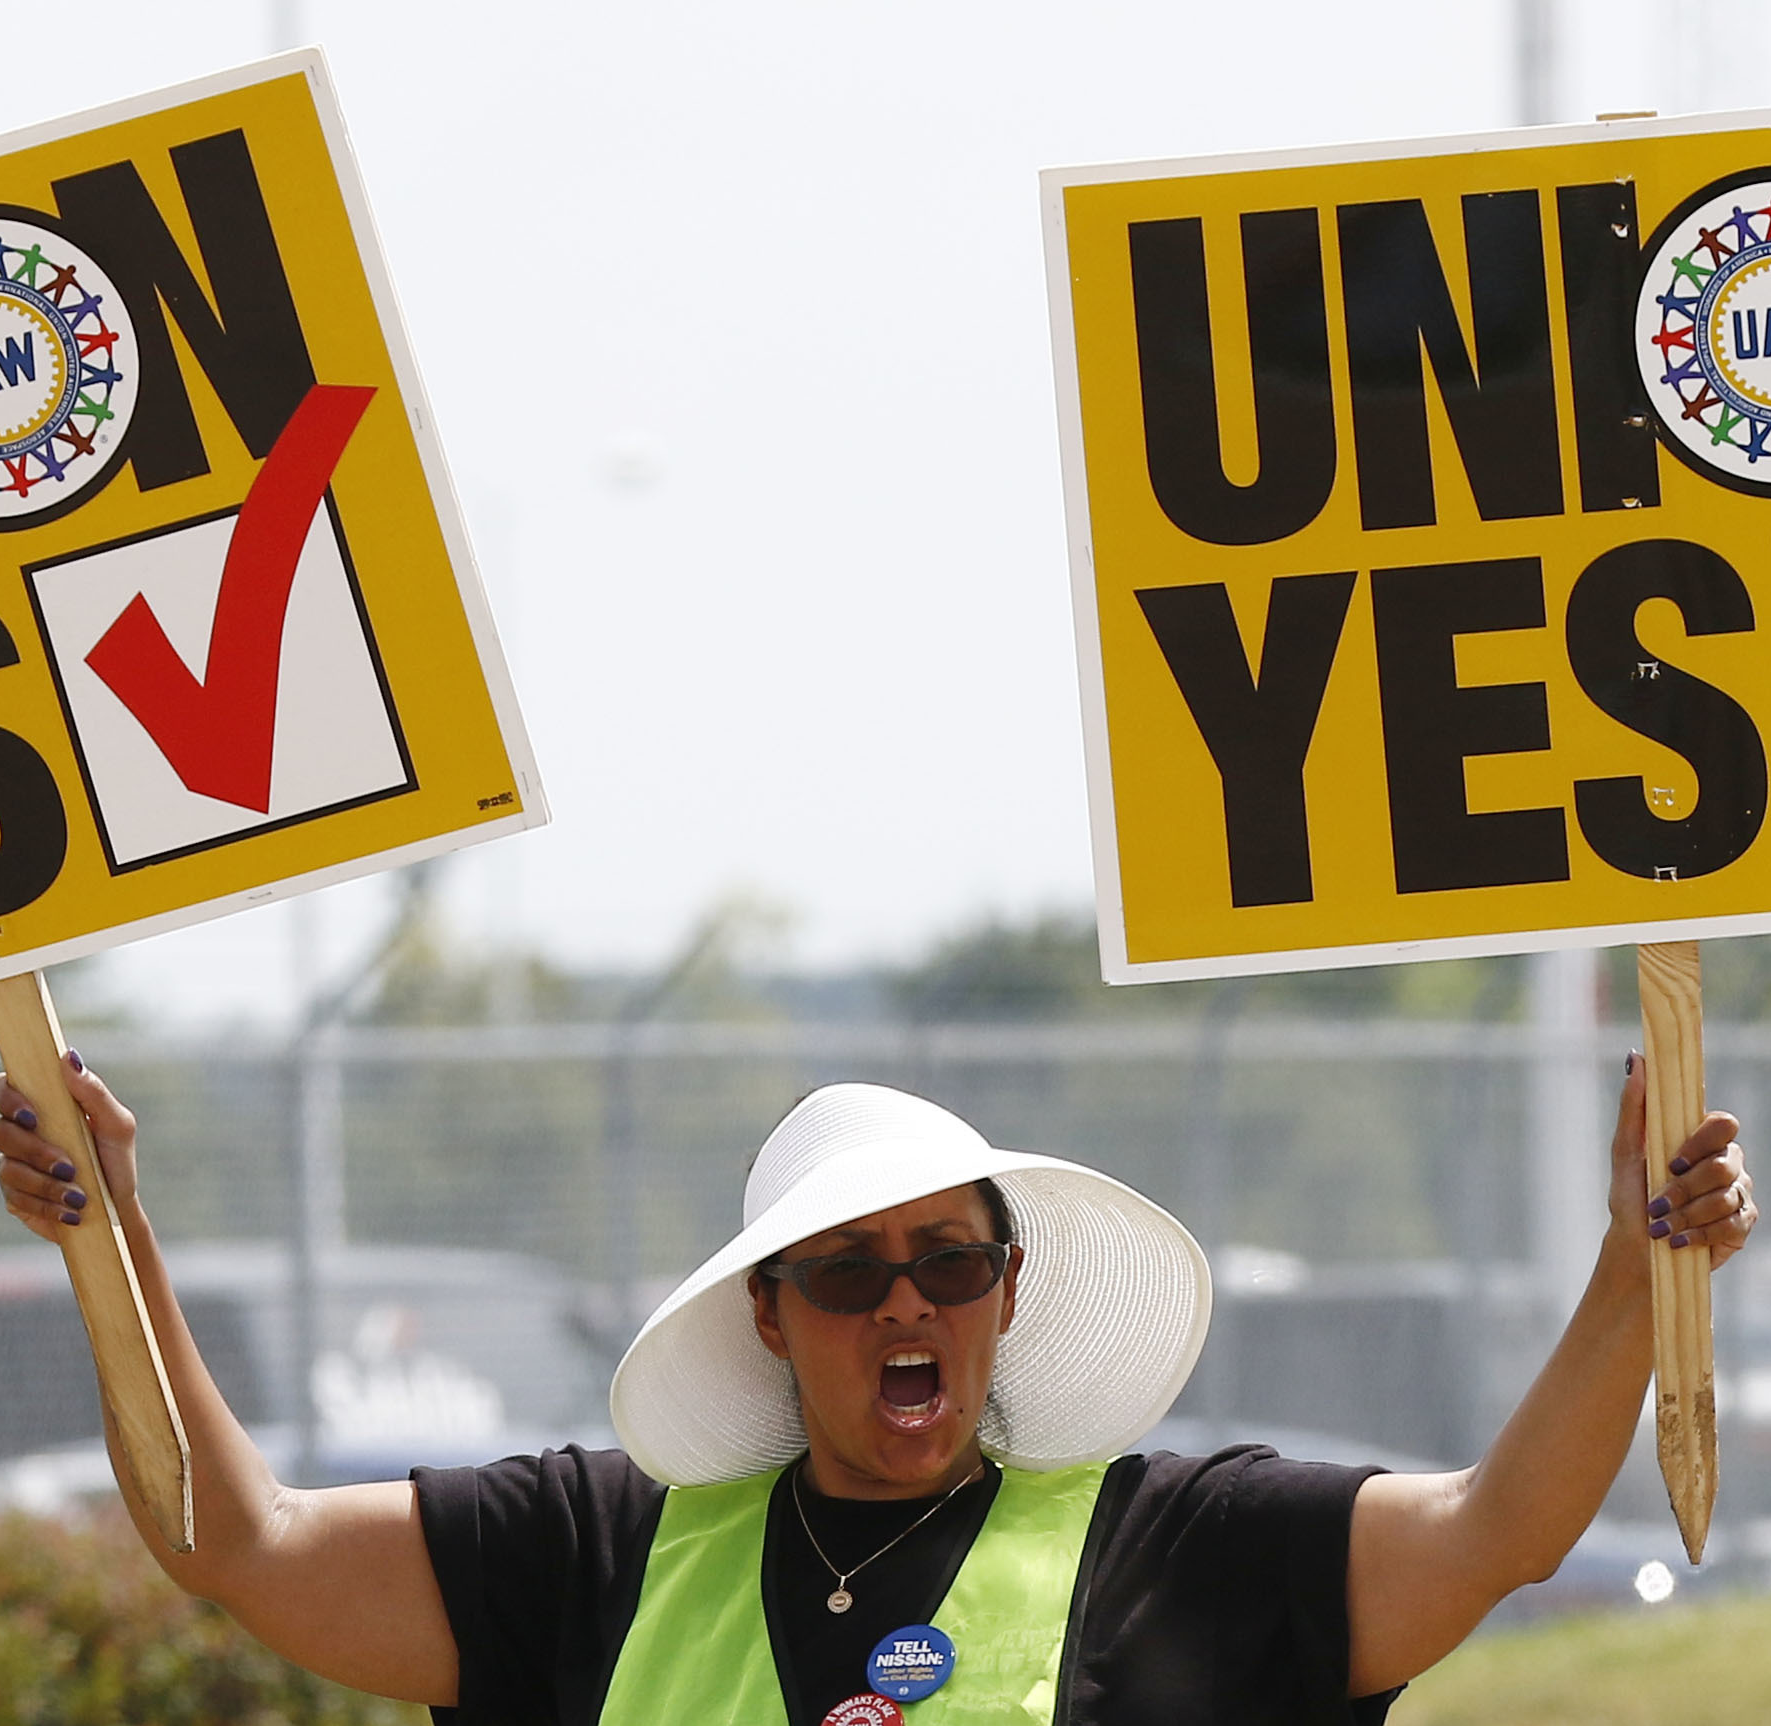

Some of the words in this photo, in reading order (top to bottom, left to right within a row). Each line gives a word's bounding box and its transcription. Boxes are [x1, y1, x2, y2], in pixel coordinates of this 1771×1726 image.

[1719, 268, 1731, 280] OF
[1730, 249, 1764, 271] AMERICA
[48, 311, 70, 339] UNION
[65, 343, 76, 375] UNITED
[47, 377, 76, 428] AUTOMOBILE
[3, 428, 47, 453] AEROSPACE
[1133, 538, 1768, 908] YES
[876, 1653, 944, 1666] NISSAN:
[894, 1640, 932, 1654] TELL
[825, 1715, 836, 1723] A
[872, 1698, 896, 1718] PLACE
